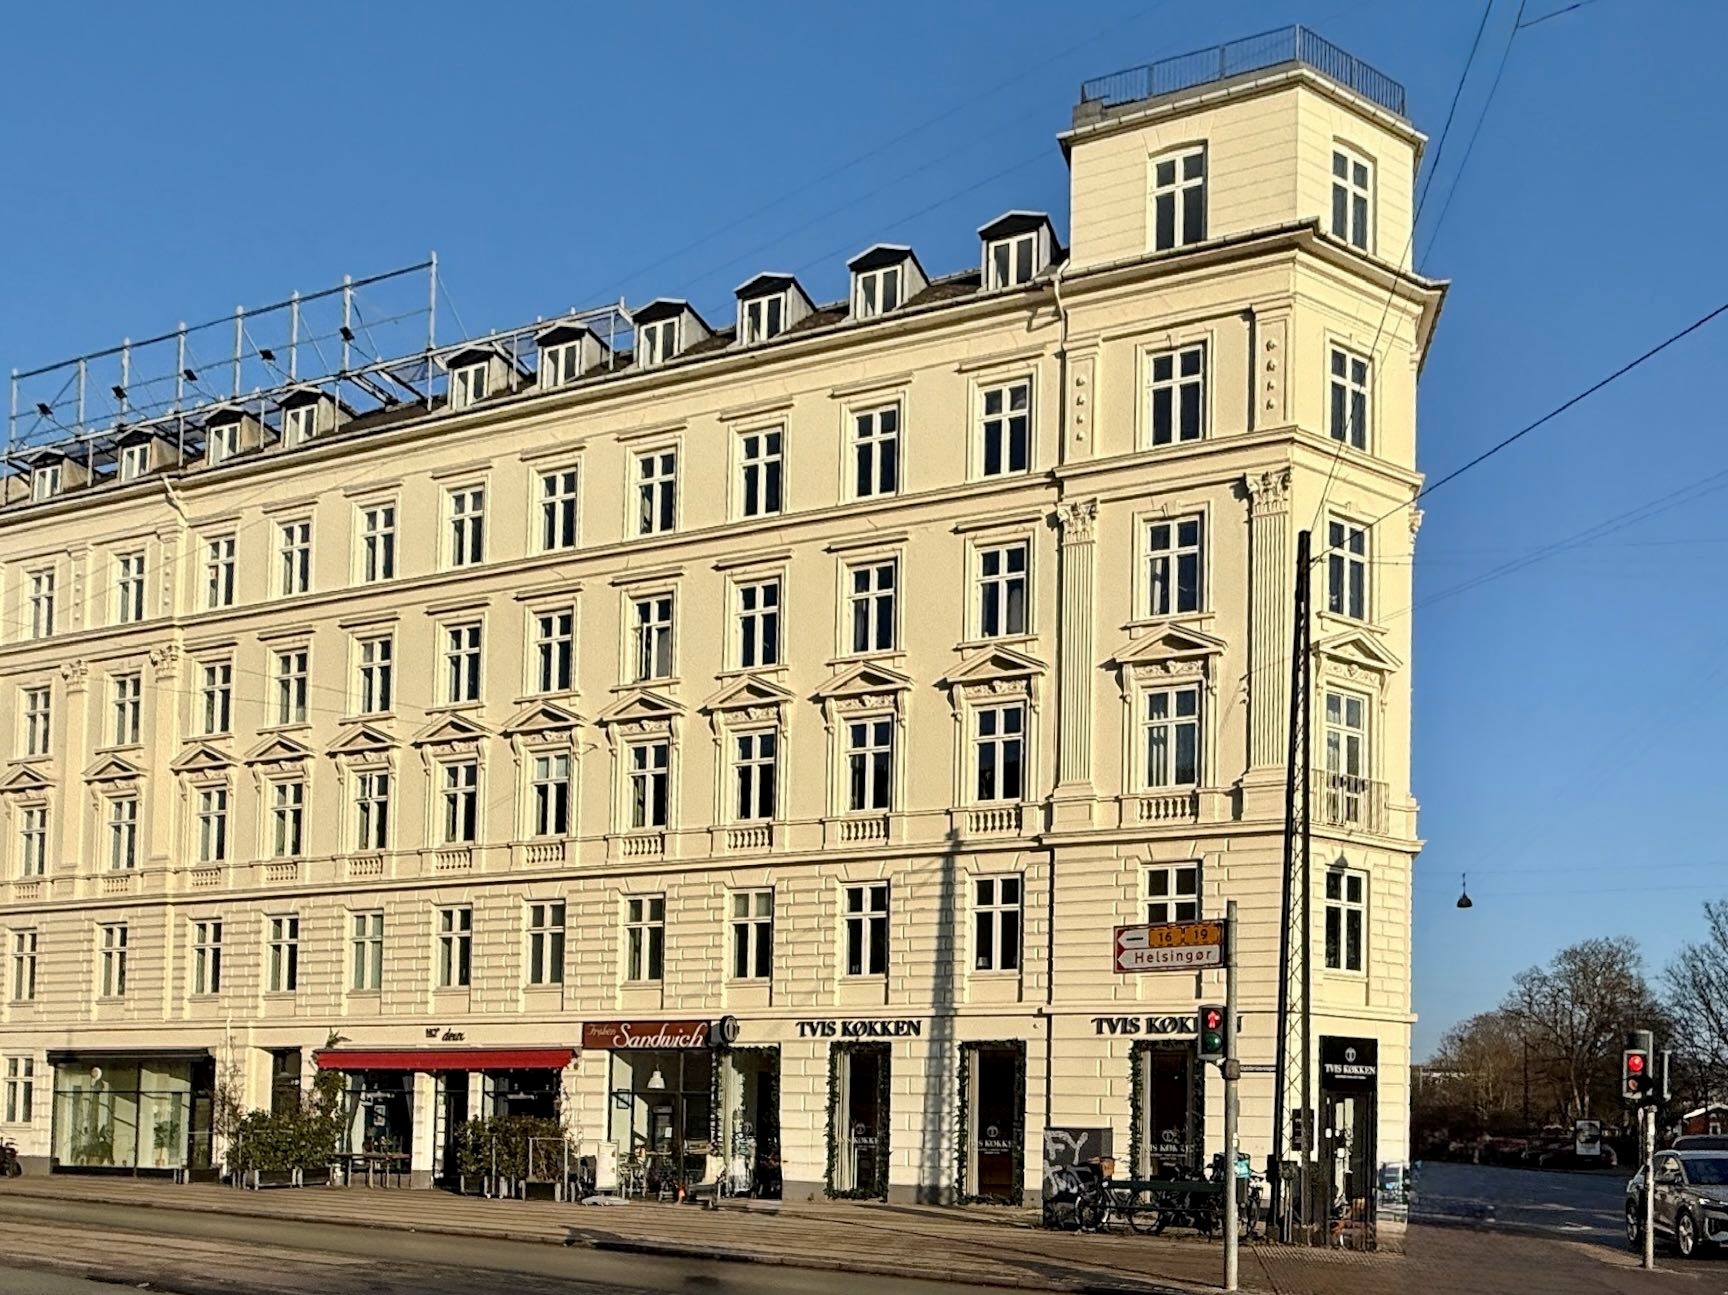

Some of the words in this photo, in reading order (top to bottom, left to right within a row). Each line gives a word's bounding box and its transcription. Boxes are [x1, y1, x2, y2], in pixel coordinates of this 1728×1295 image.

[1158, 932, 1172, 943] 16
[1194, 928, 1208, 940] 19
[1134, 949, 1212, 964] Helsingør
[795, 1020, 837, 1038] TVIS
[841, 1019, 922, 1038] KØKKEN
[1090, 1016, 1141, 1035] TVIS
[612, 1022, 708, 1048] Sandwich
[1324, 1063, 1342, 1074] TVIS
[1342, 1064, 1376, 1076] KØKKEN
